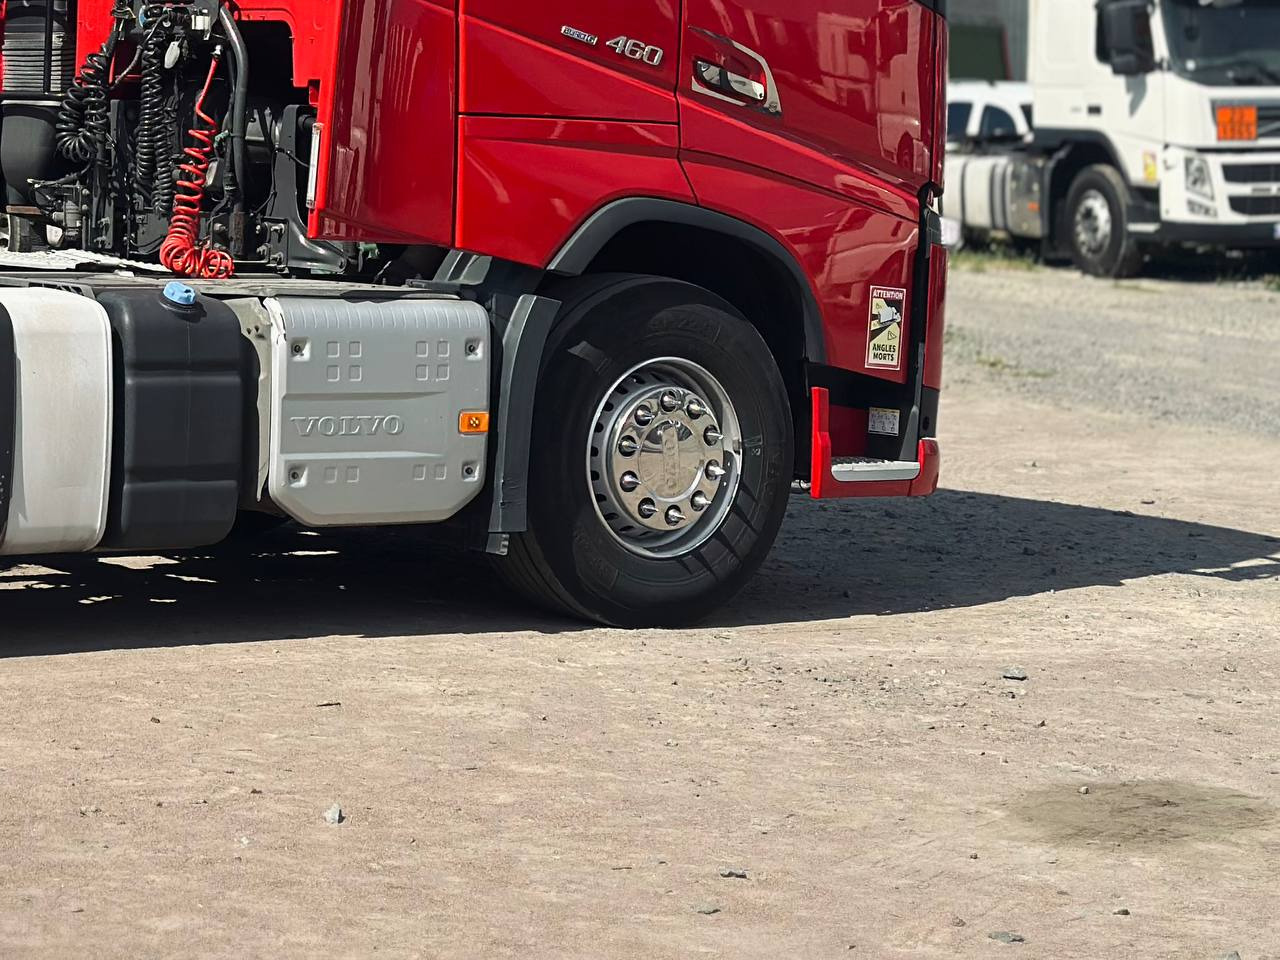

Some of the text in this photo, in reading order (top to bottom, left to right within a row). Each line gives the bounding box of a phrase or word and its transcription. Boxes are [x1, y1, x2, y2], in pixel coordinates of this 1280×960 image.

[605, 35, 664, 66] 460
[872, 289, 903, 300] ATTENTION
[872, 343, 896, 353] ANGLES
[872, 352, 895, 362] MORTS
[290, 413, 405, 436] VOLVO
